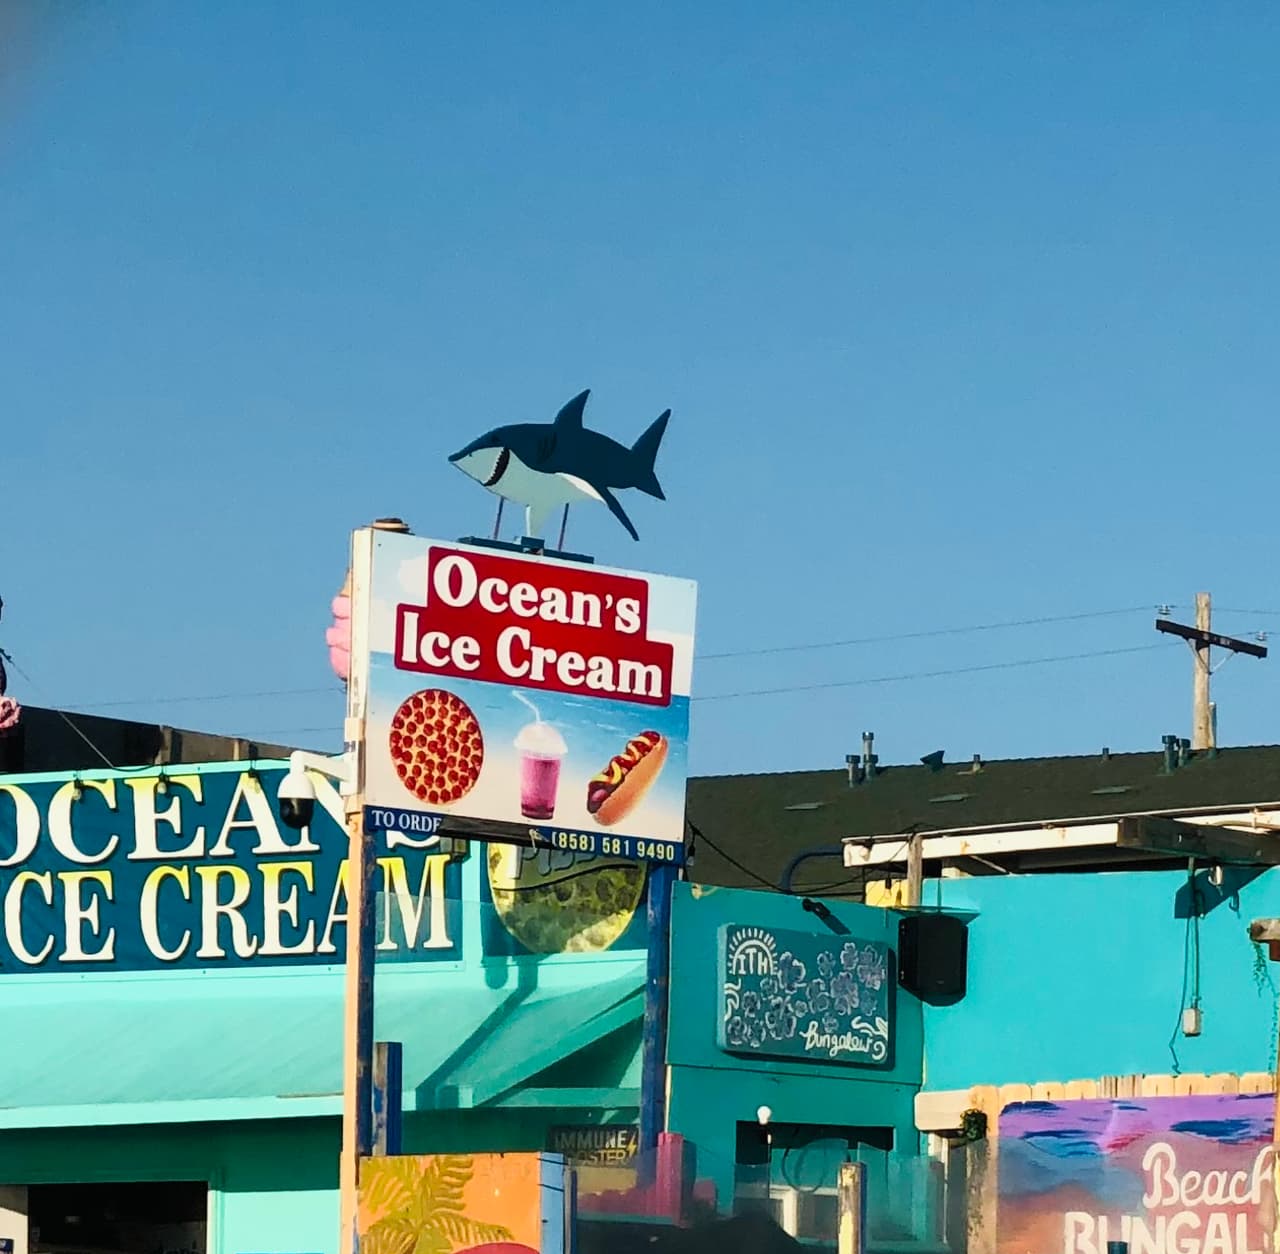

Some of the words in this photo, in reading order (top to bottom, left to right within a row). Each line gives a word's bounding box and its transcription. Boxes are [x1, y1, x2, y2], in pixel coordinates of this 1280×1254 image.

[433, 555, 642, 634] Ocean's
[401, 611, 482, 671] Ice
[496, 626, 664, 699] Cream
[371, 810, 395, 828] TO
[602, 837, 630, 855] 581
[637, 842, 675, 861] 9490
[554, 1129, 627, 1149] IMMUNE
